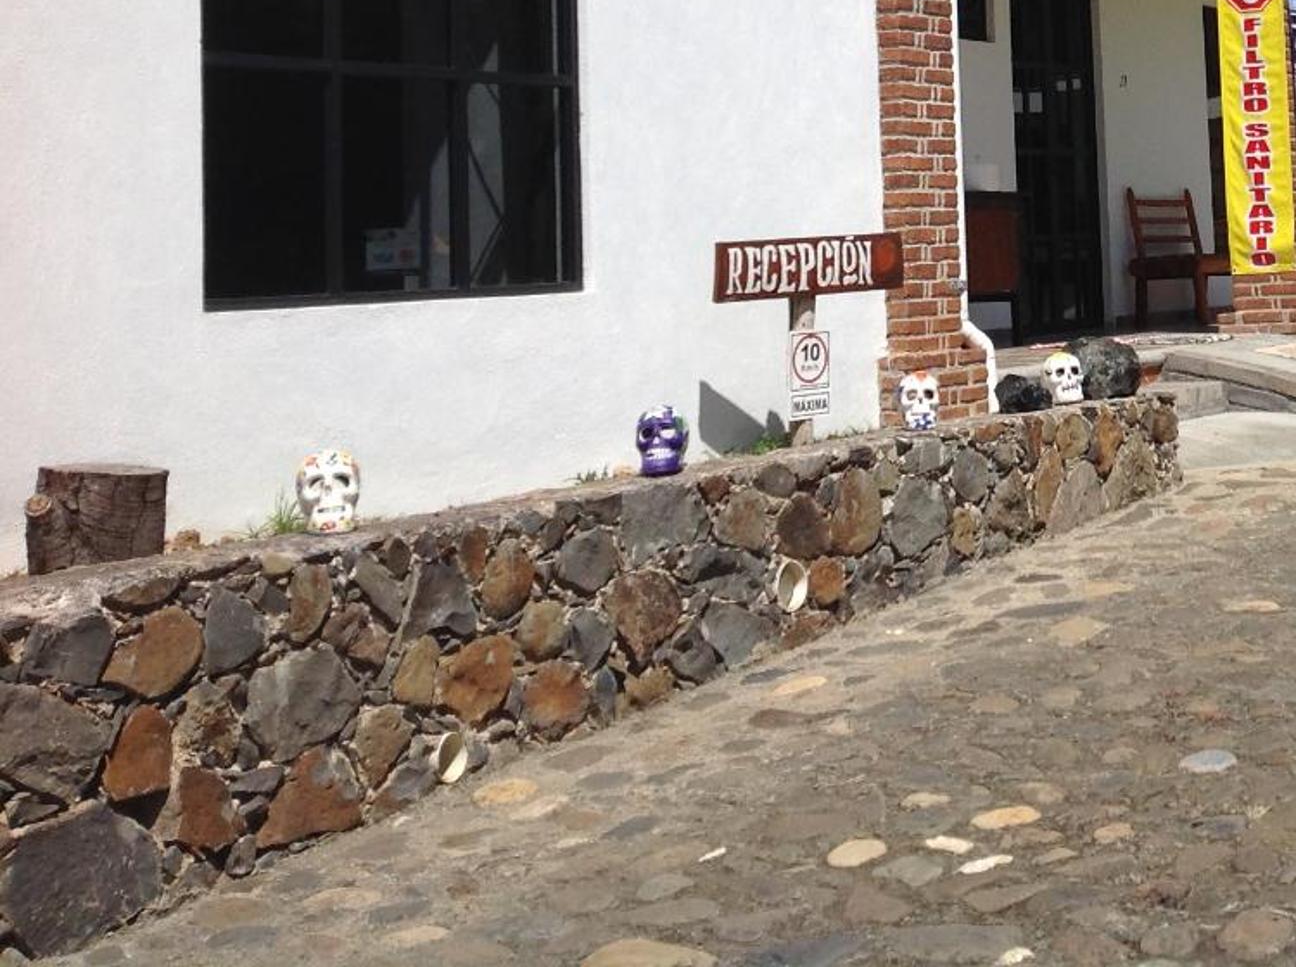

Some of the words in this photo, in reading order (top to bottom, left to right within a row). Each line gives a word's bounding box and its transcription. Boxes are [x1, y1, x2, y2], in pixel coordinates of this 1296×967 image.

[1243, 17, 1269, 113] FILTRO
[1244, 123, 1277, 268] SANITARIO
[725, 236, 874, 296] RECEPCIÓN
[801, 342, 820, 362] 10
